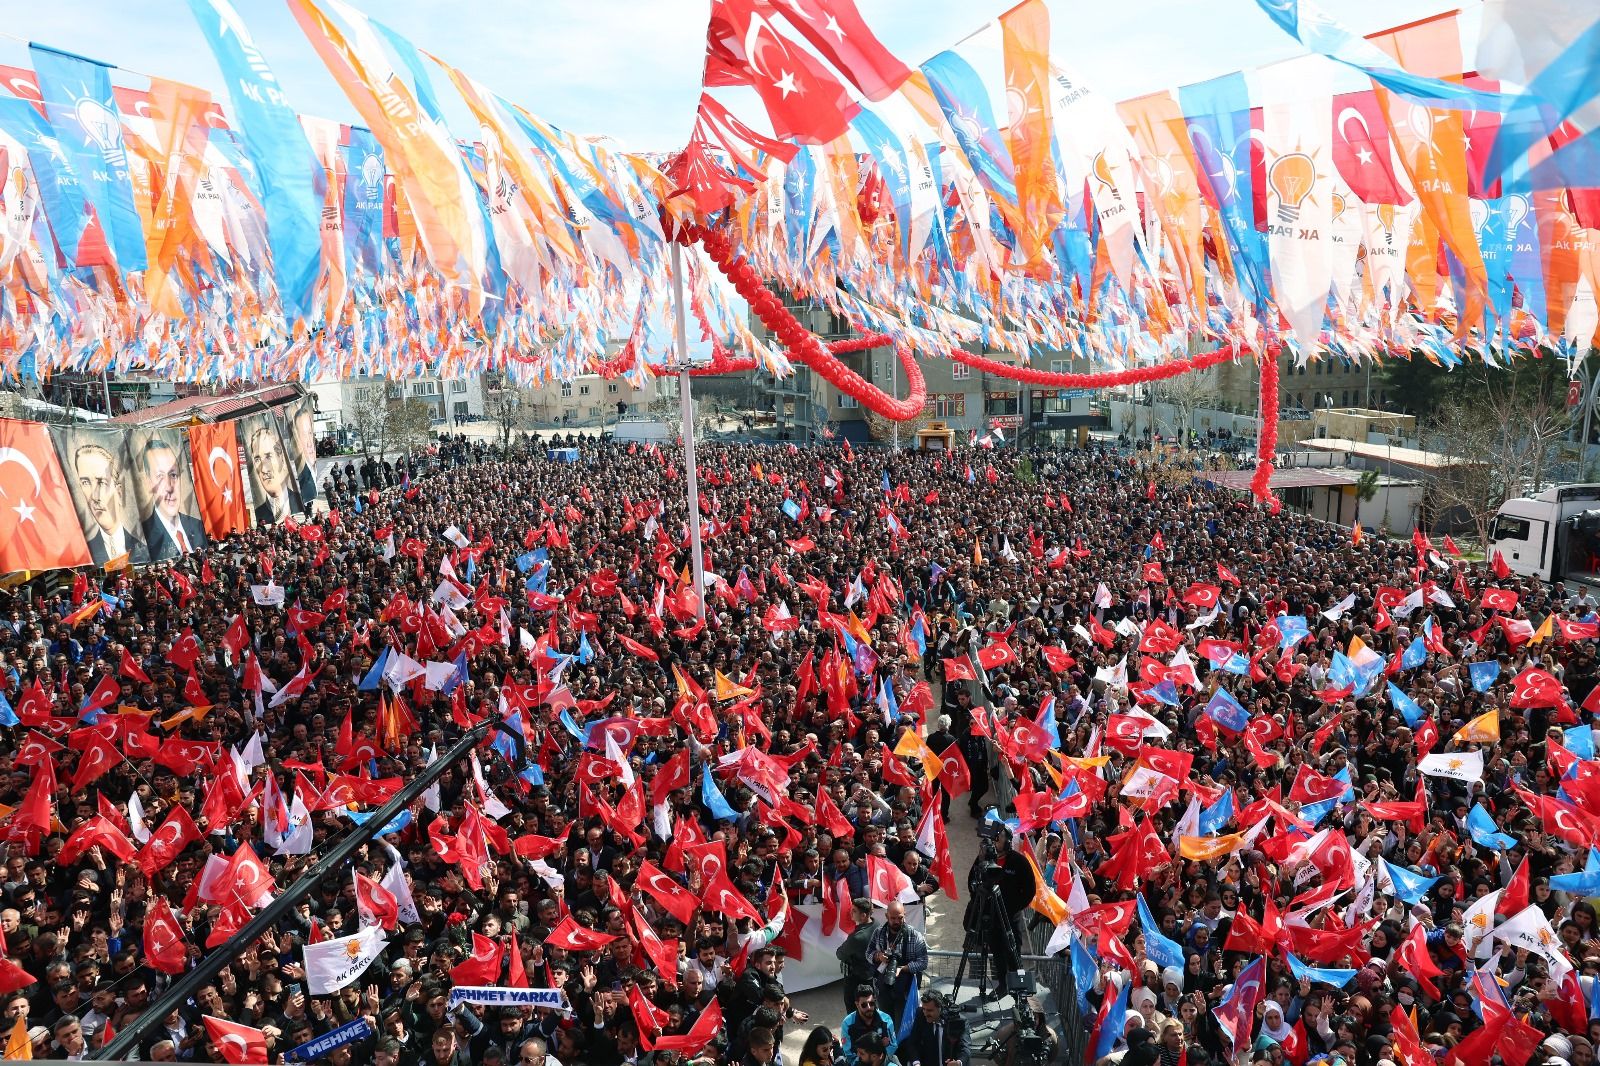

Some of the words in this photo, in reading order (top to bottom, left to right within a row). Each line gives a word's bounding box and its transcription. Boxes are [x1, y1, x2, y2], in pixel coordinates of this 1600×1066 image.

[92, 170, 113, 181] AK
[356, 201, 366, 209] AK
[1555, 241, 1570, 250] AK
[1519, 932, 1534, 943] AK
[336, 971, 347, 983] AK
[452, 988, 507, 1002] MEHMET
[509, 990, 559, 1003] YARKA
